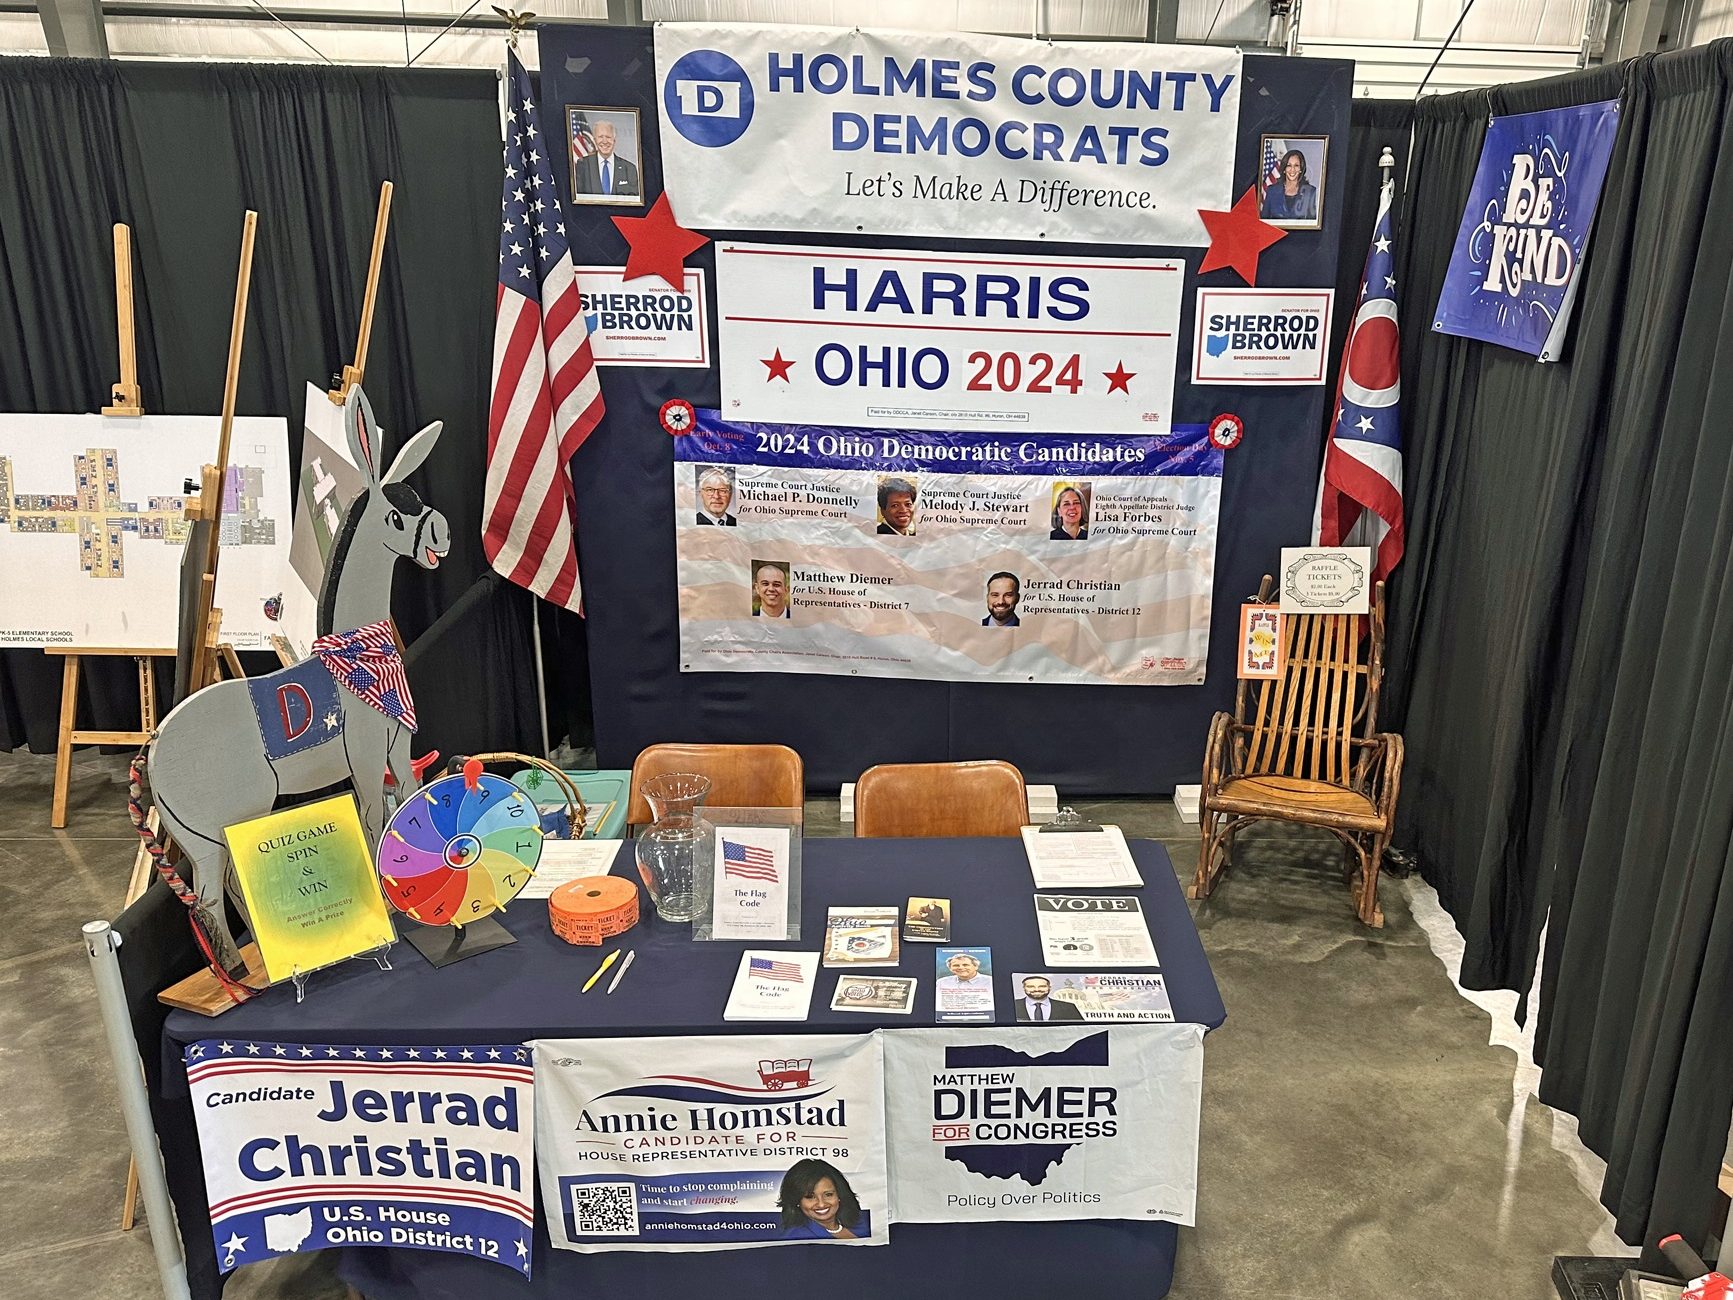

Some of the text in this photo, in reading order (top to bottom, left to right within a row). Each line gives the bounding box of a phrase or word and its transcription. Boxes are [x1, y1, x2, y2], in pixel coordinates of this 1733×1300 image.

[768, 52, 1235, 113] HOLMES COUNTY
[695, 83, 724, 113] D
[831, 111, 1170, 167] DEMOCRATS
[845, 171, 1158, 213] Let's Make A Difference.
[1502, 153, 1554, 225] BE
[1482, 224, 1572, 297] KIND
[813, 266, 1091, 322] HARRIS
[580, 293, 693, 313] SHERROD
[601, 312, 694, 331] BROWN
[1209, 315, 1319, 332] SHERROD
[1231, 333, 1317, 350] BROWN
[814, 342, 1084, 395] OHIO 2024
[716, 430, 744, 441] Voting
[756, 432, 1145, 463] 2024 Ohio Democratic Candidates
[738, 479, 840, 493] Supreme Court Justice
[739, 490, 860, 509] Michael P. Donnelly
[921, 489, 1022, 500] Supreme Court Justice
[737, 505, 848, 518] for Ohio Supreme Court
[921, 499, 1029, 513] Melody J. Stewart
[1118, 503, 1149, 511] Appellate
[1176, 504, 1195, 512] Judge
[919, 514, 1027, 526] for Ohio Supreme Court
[1094, 512, 1162, 522] Lisa Forbes
[1091, 526, 1197, 536] for Ohio Supreme Court
[793, 571, 893, 584] Matthew Diemer
[1023, 579, 1121, 591] Jerrad Christian
[791, 586, 867, 596] for U.S. House of
[1022, 593, 1096, 602] for U.S. House of
[793, 598, 861, 608] Representatives
[870, 601, 902, 610] District
[1023, 605, 1089, 615] Representatives
[1097, 607, 1129, 615] District
[276, 682, 314, 742] D
[442, 794, 452, 808] 8
[507, 804, 524, 818] 10
[408, 817, 421, 829] 7
[257, 822, 338, 855] QUIZ GAME
[287, 845, 319, 864] SPIN
[516, 842, 532, 853] 1
[302, 866, 314, 877] &
[503, 874, 516, 888] 2
[298, 880, 329, 898] WIN
[401, 885, 416, 898] 5
[734, 889, 767, 898] The Flag
[286, 896, 353, 923] Answer Correctly
[433, 901, 445, 916] 4
[471, 899, 481, 912] 3
[1045, 898, 1129, 910] VOTE
[300, 910, 345, 930] Win A Prize
[598, 914, 615, 924] TICKET
[933, 1072, 1015, 1086] MATTHEW
[205, 1080, 519, 1132] Candidate Jerrad
[934, 1086, 1117, 1121] DIEMER
[574, 1098, 847, 1134] Annie Homstad
[932, 1120, 1117, 1140] FOR CONGRESS
[624, 1131, 797, 1149] CANDIDATE FOR
[579, 1146, 849, 1163] HOUSE REPRESENTATIVE DISTRICT 98
[238, 1134, 522, 1193] Christian
[640, 1180, 774, 1193] Time to stop complaining
[641, 1195, 739, 1206] and start changing.
[947, 1191, 1101, 1208] Policy Over Politics
[323, 1206, 451, 1226] U.S. House
[645, 1222, 776, 1231] anniehomstad4ohio.com
[326, 1227, 500, 1258] Ohio District 12
